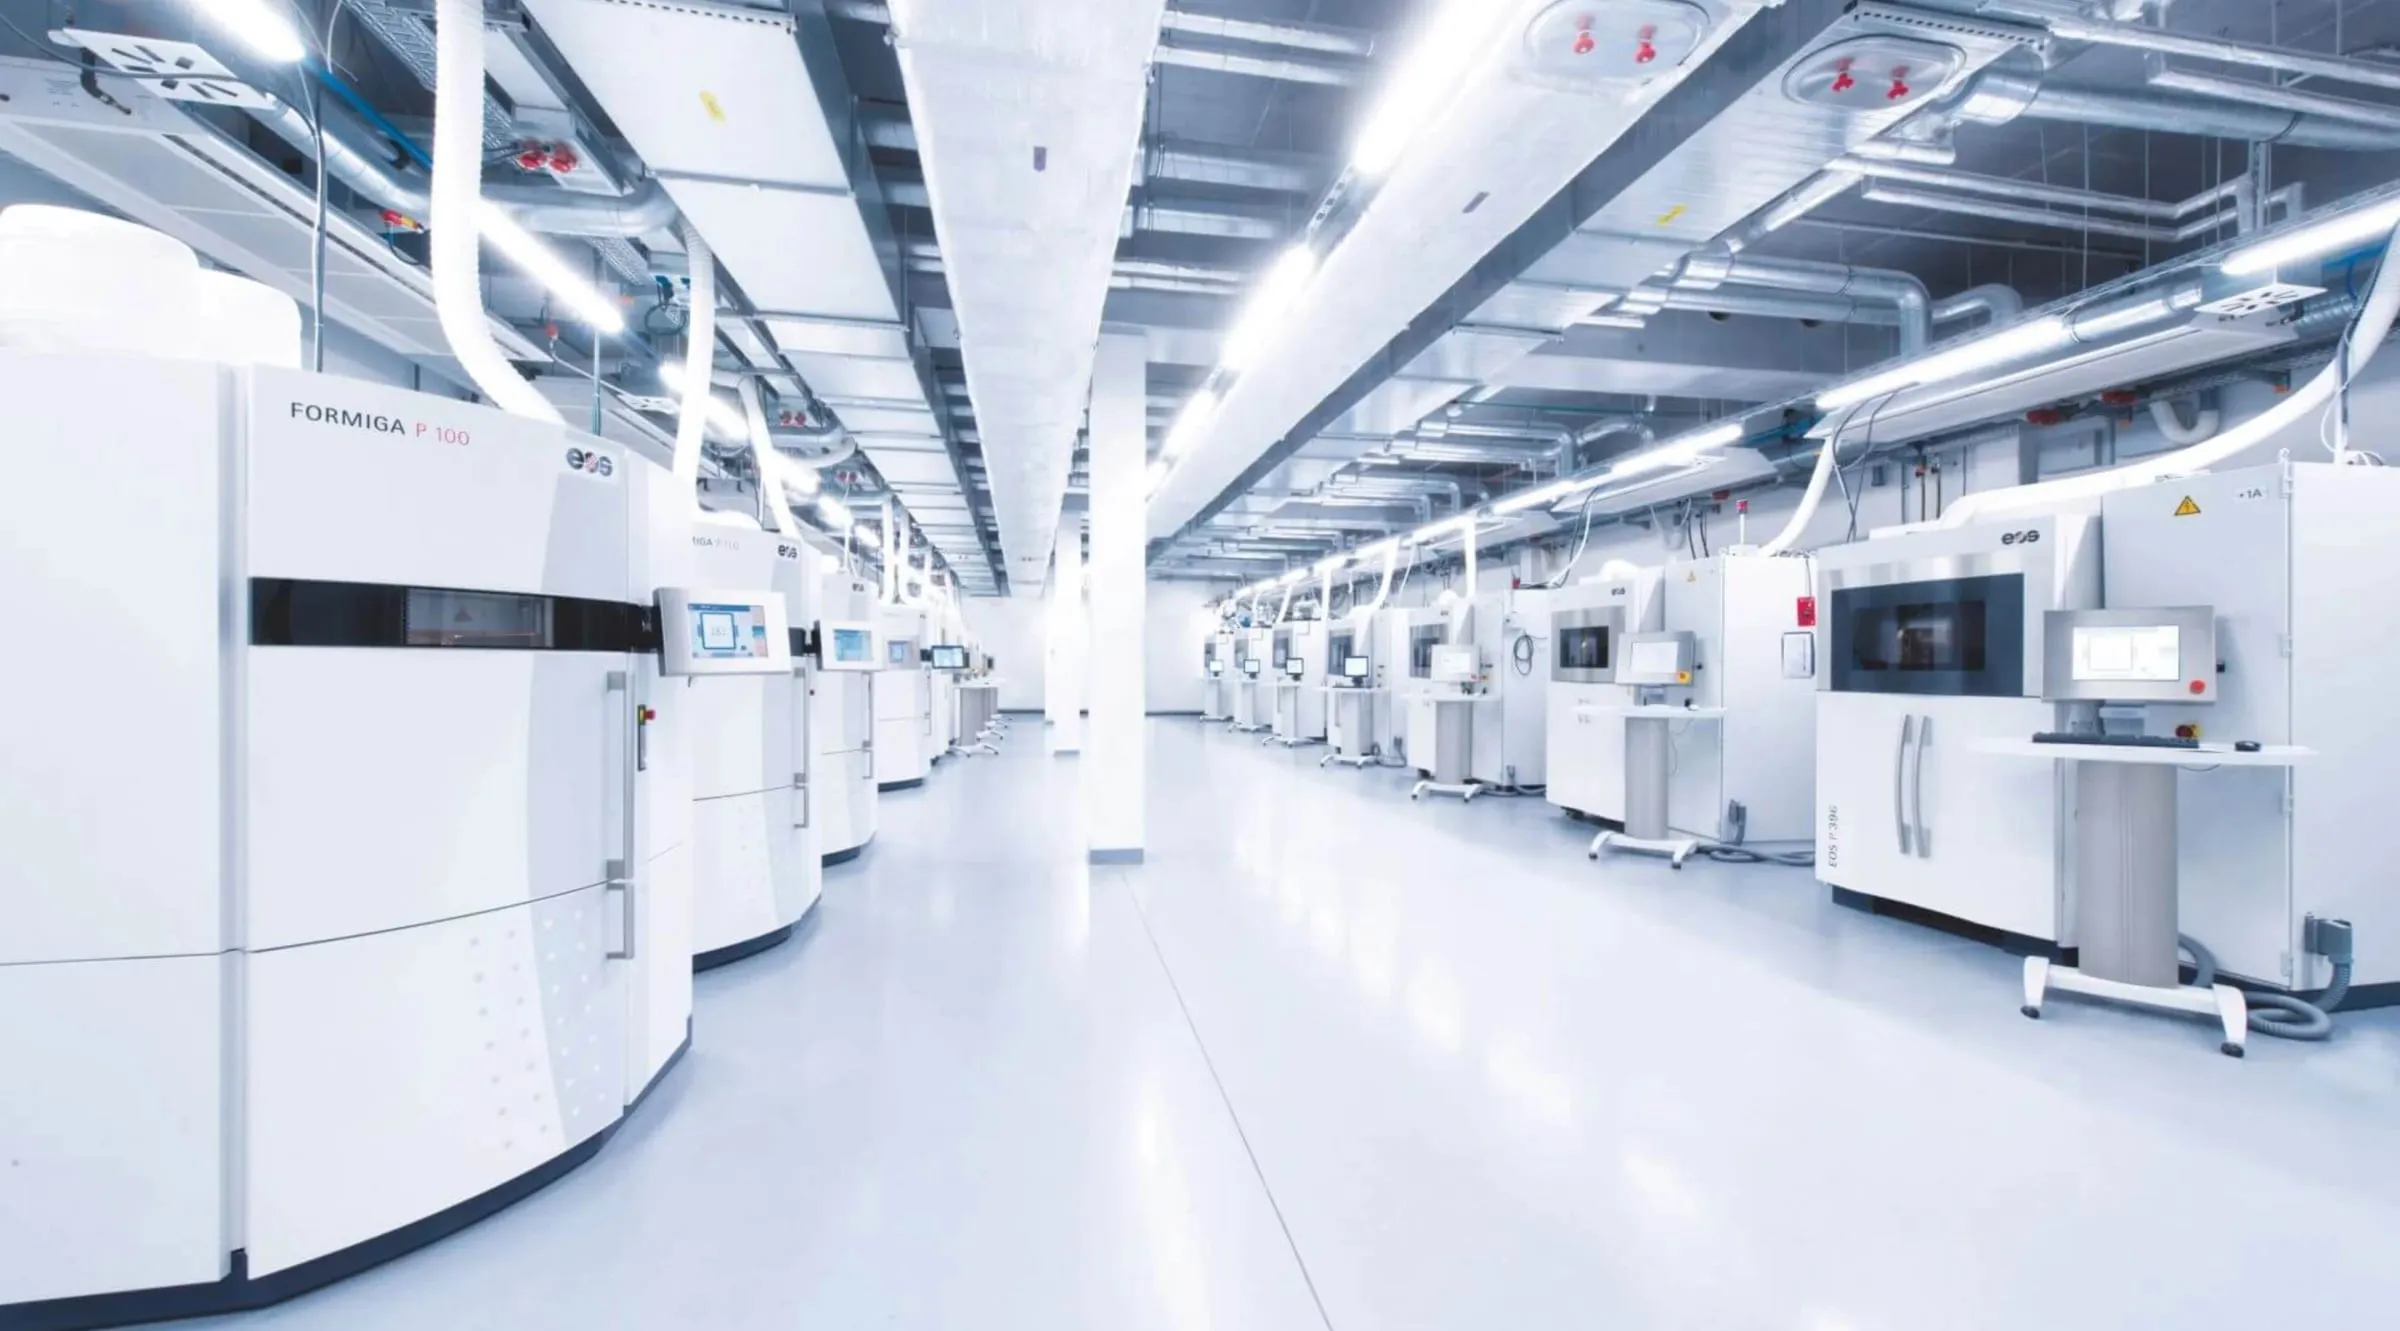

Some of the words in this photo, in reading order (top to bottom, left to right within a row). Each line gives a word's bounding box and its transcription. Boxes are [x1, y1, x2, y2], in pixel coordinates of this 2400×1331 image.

[290, 401, 406, 436] FORMIGA
[415, 422, 427, 438] P
[436, 426, 471, 446] 100
[566, 447, 613, 477] eos
[2001, 529, 2041, 545] eos
